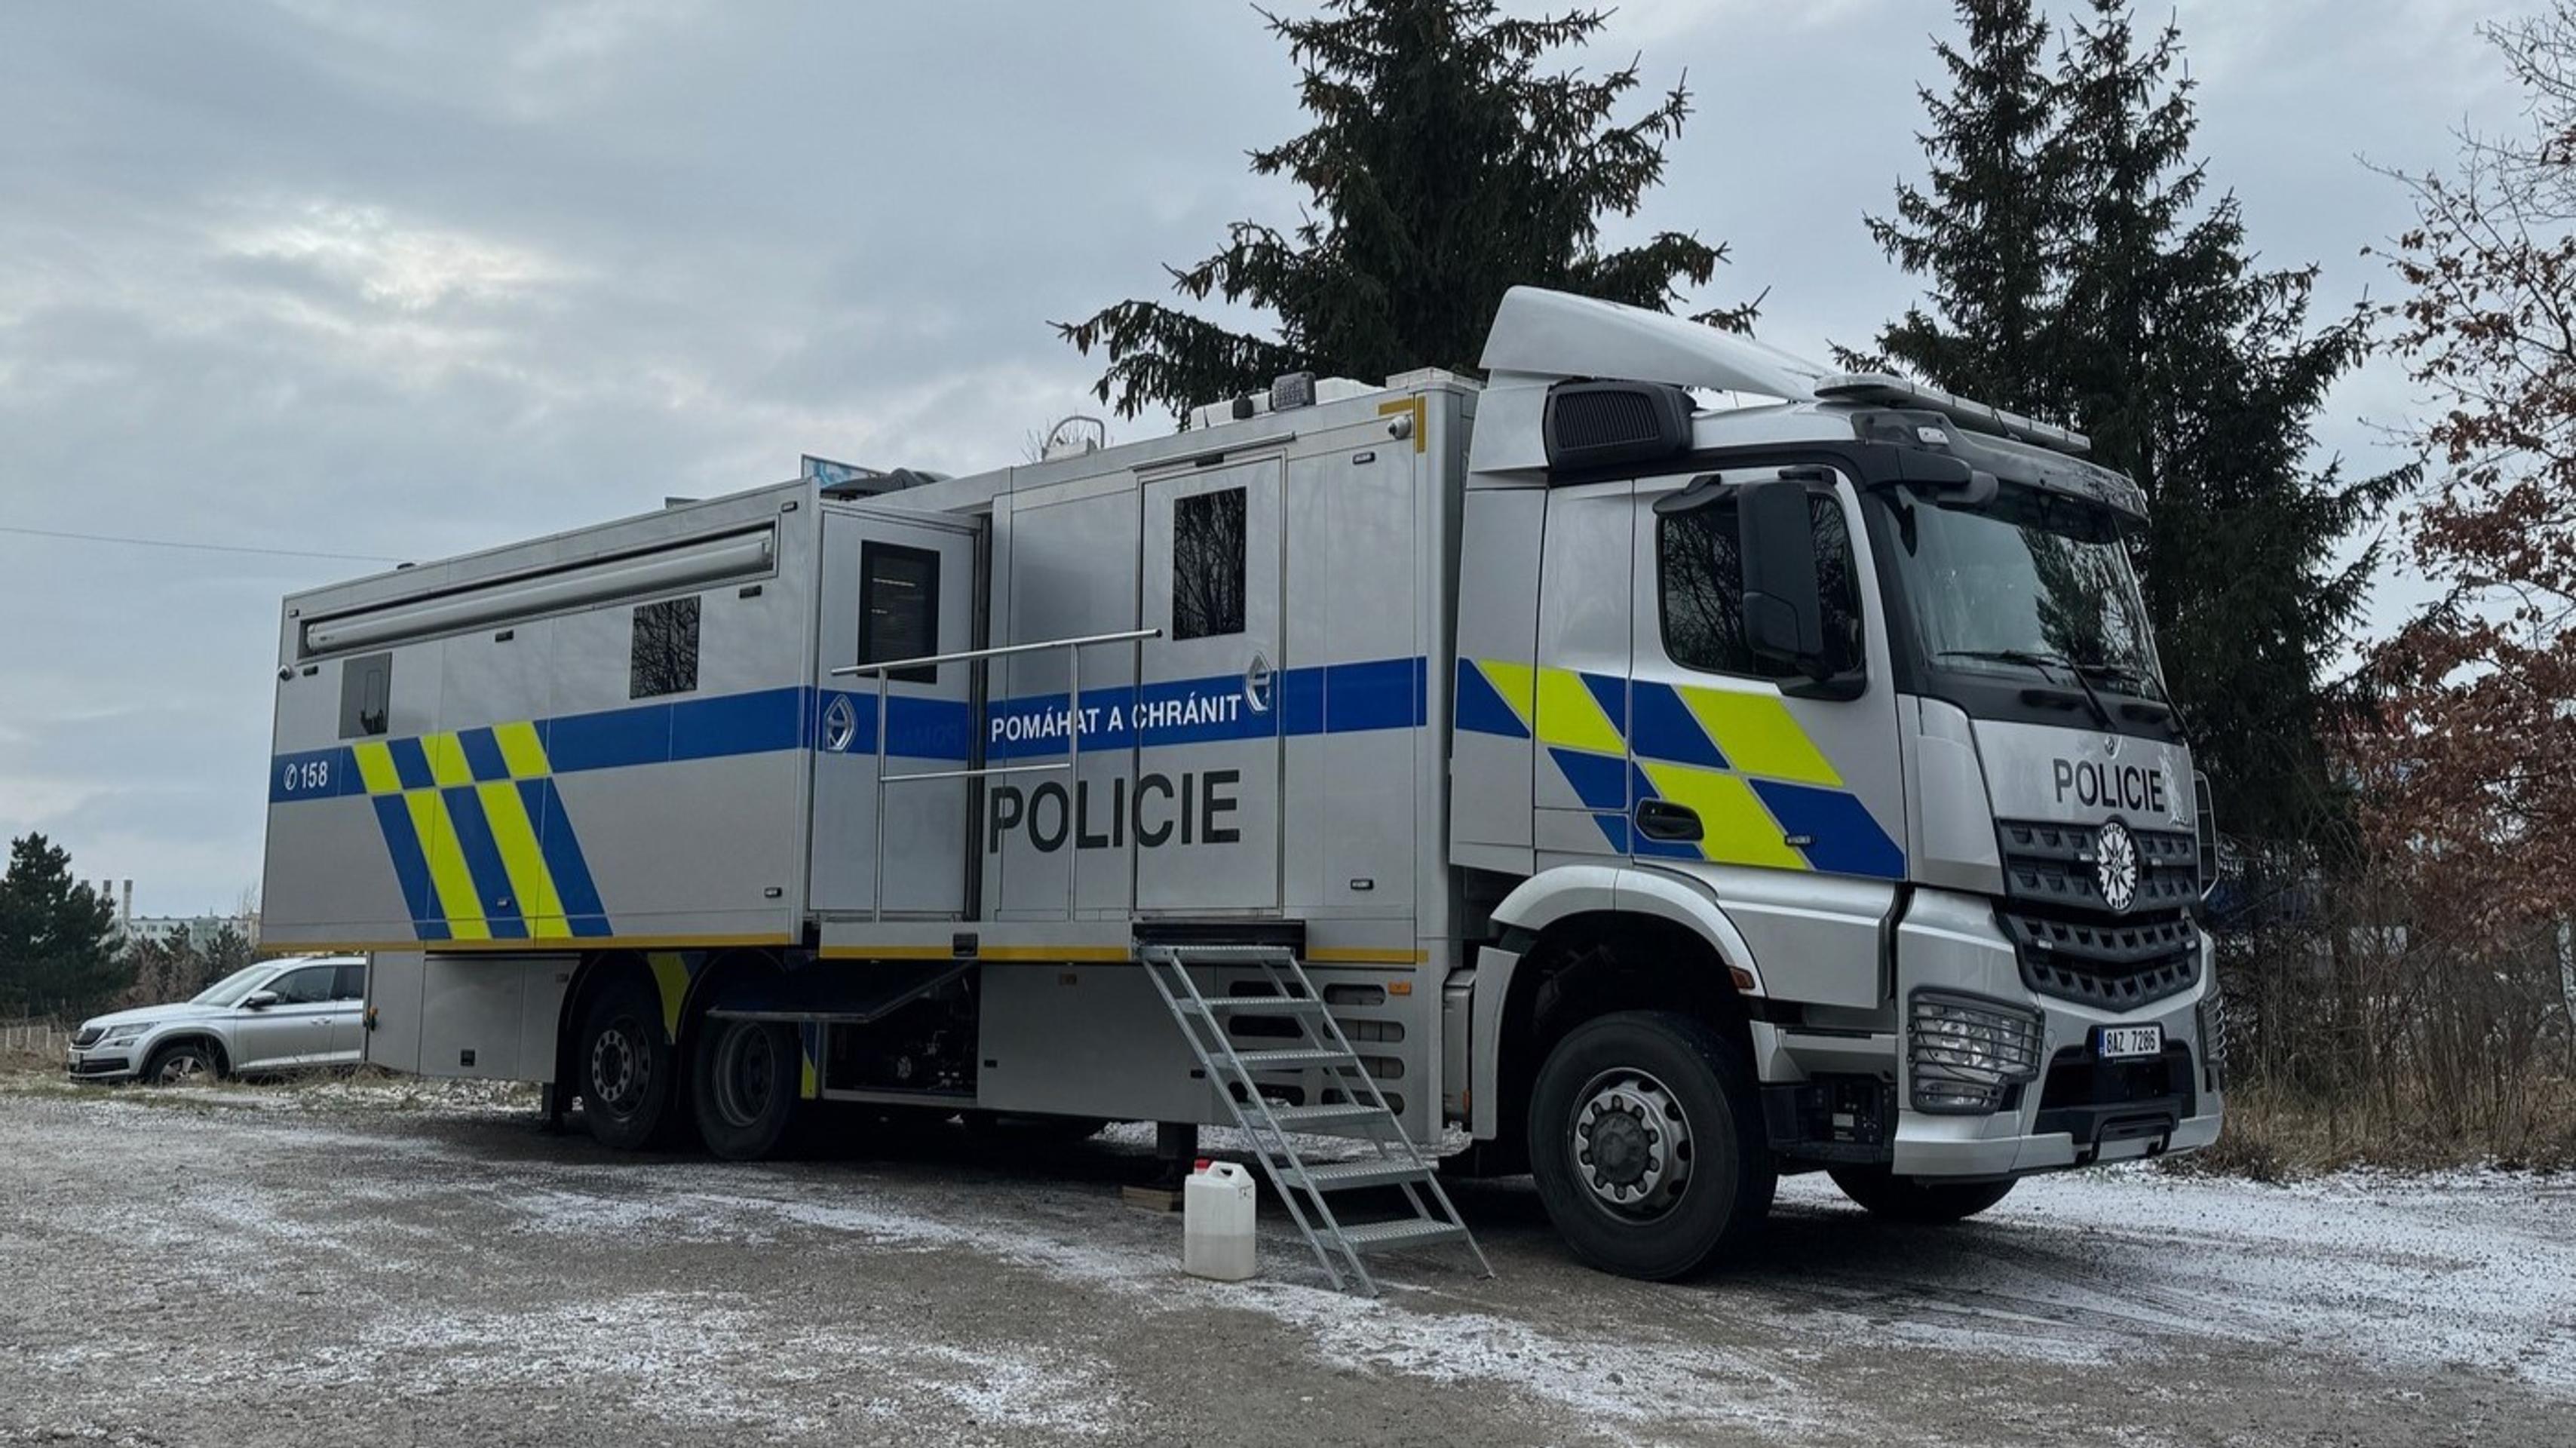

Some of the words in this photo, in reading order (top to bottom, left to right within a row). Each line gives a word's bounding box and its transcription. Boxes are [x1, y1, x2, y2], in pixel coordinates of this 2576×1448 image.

[991, 706, 1100, 742] POMÁHAT
[1107, 705, 1124, 732] A
[1132, 692, 1242, 729] CHRÁNIT
[301, 760, 328, 789] 158
[2053, 758, 2165, 812] POLICIE
[989, 769, 1240, 854] POLICIE
[2132, 1029, 2155, 1052] 7286
